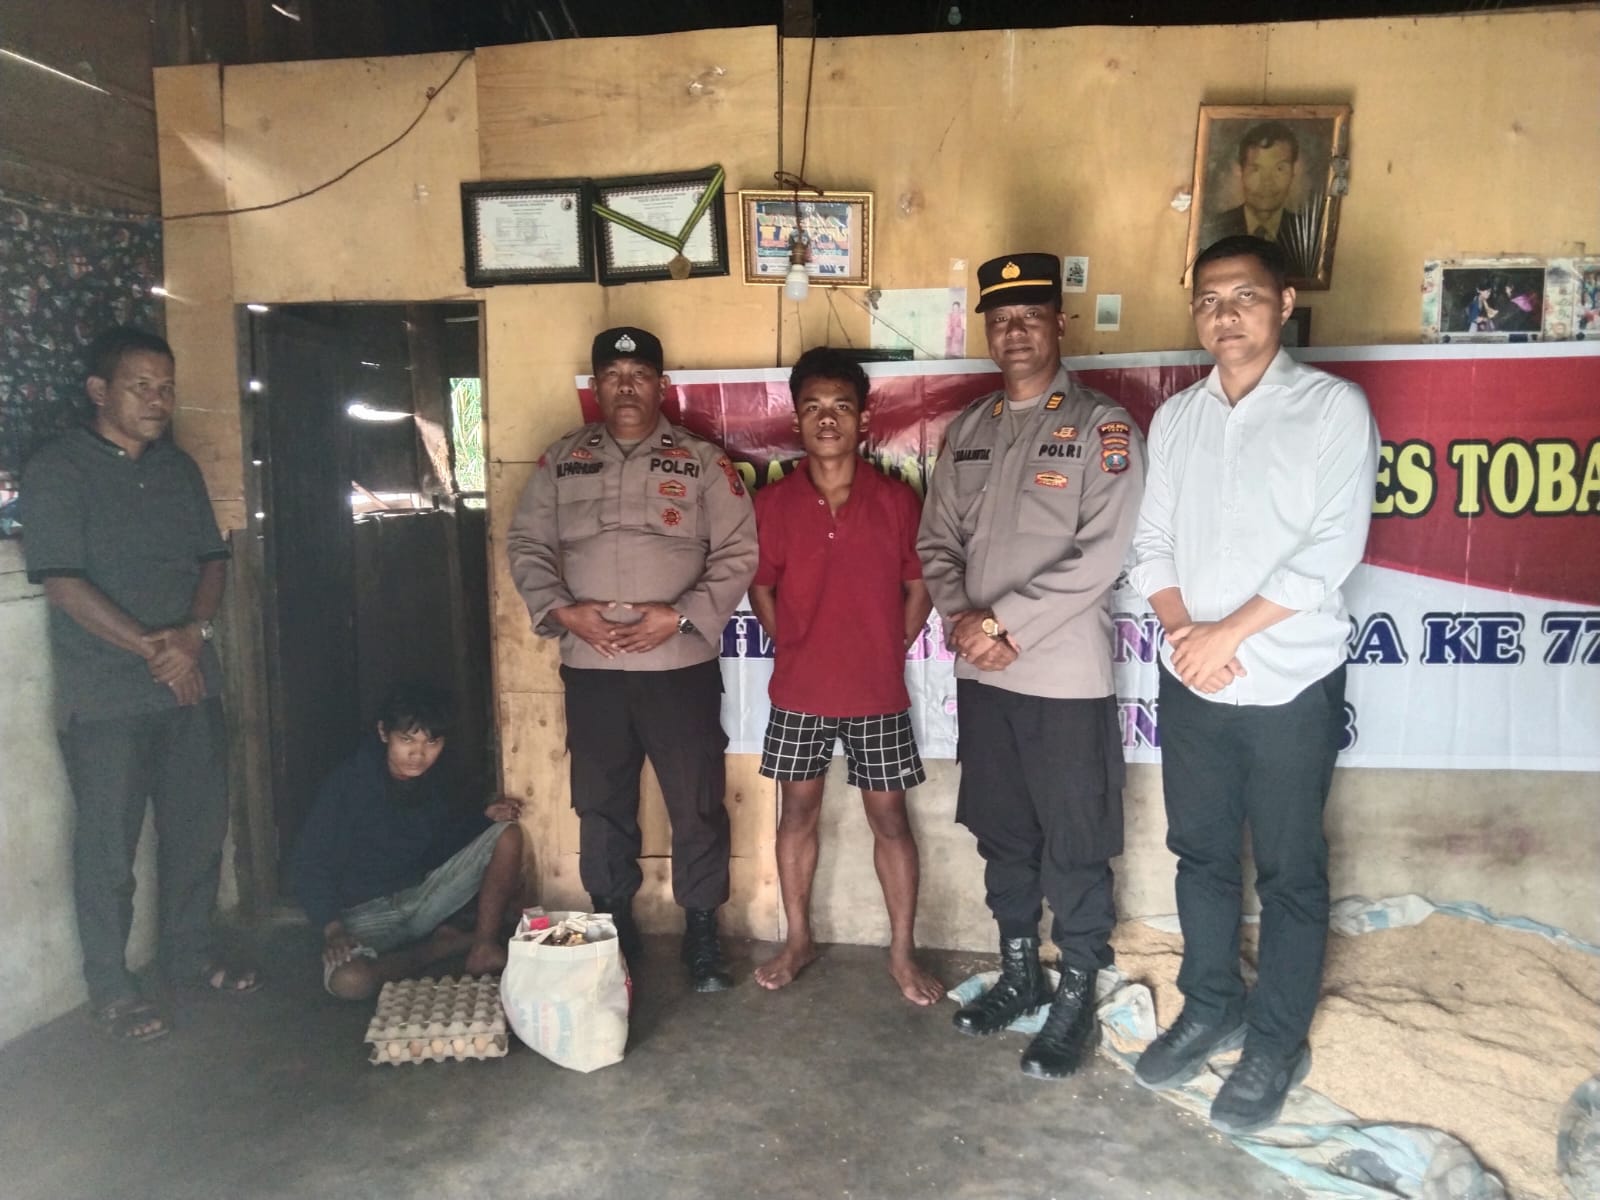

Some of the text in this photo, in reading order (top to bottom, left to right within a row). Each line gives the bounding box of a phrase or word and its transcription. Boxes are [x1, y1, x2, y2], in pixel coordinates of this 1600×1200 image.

[1039, 444, 1082, 458] POLRI
[650, 457, 700, 479] POLRI
[1420, 611, 1526, 666] KE
